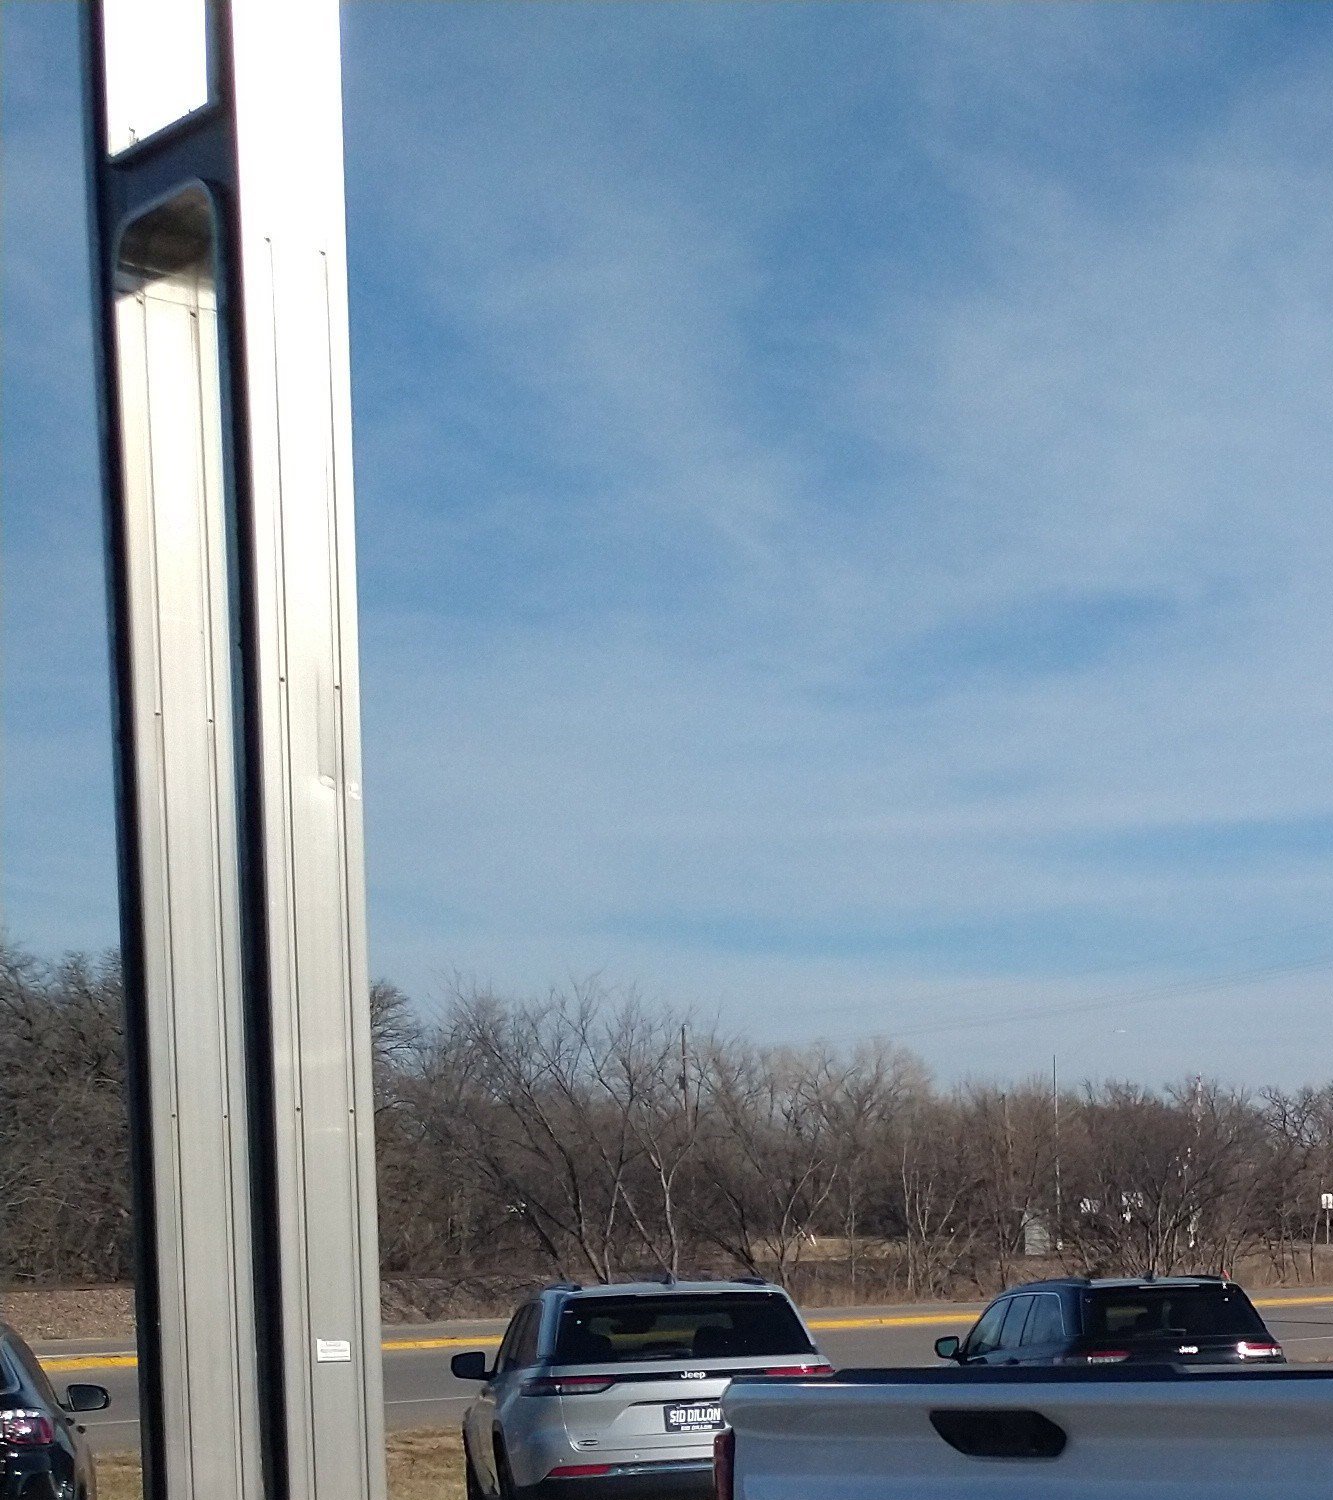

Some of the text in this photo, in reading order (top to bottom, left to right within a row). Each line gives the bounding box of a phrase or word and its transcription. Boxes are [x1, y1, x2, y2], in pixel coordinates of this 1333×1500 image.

[681, 1371, 706, 1379] Jeep
[670, 1408, 721, 1423] SID DILLON
